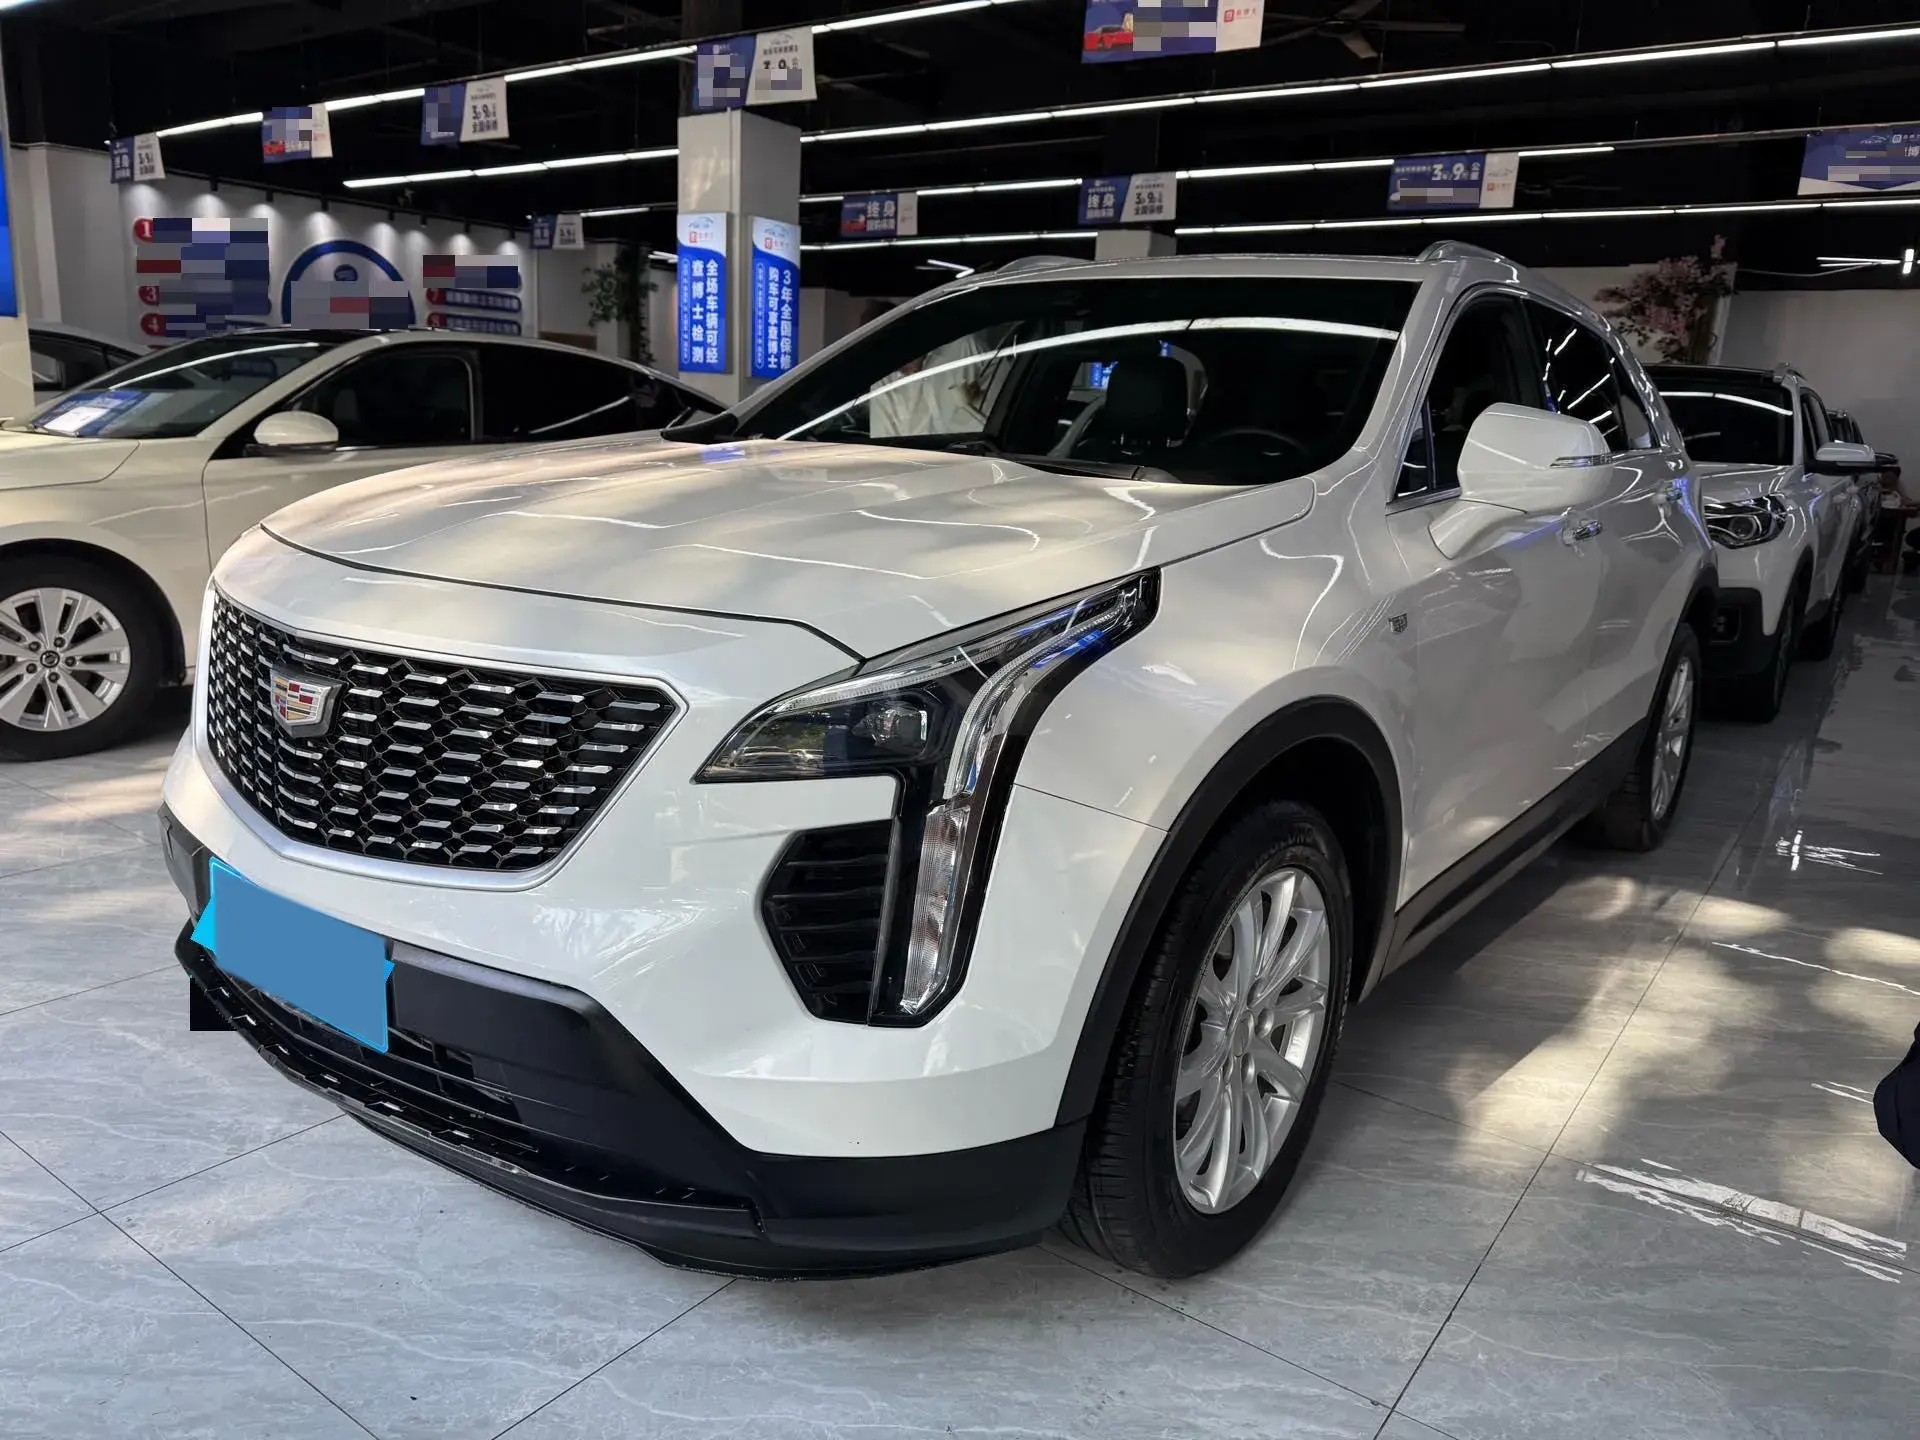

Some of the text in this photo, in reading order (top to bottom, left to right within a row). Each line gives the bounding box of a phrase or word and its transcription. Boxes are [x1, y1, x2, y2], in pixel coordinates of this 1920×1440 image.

[692, 259, 704, 364] 查博士检测
[706, 259, 718, 364] 全场车辆可经
[780, 269, 793, 370] 3年全国保修
